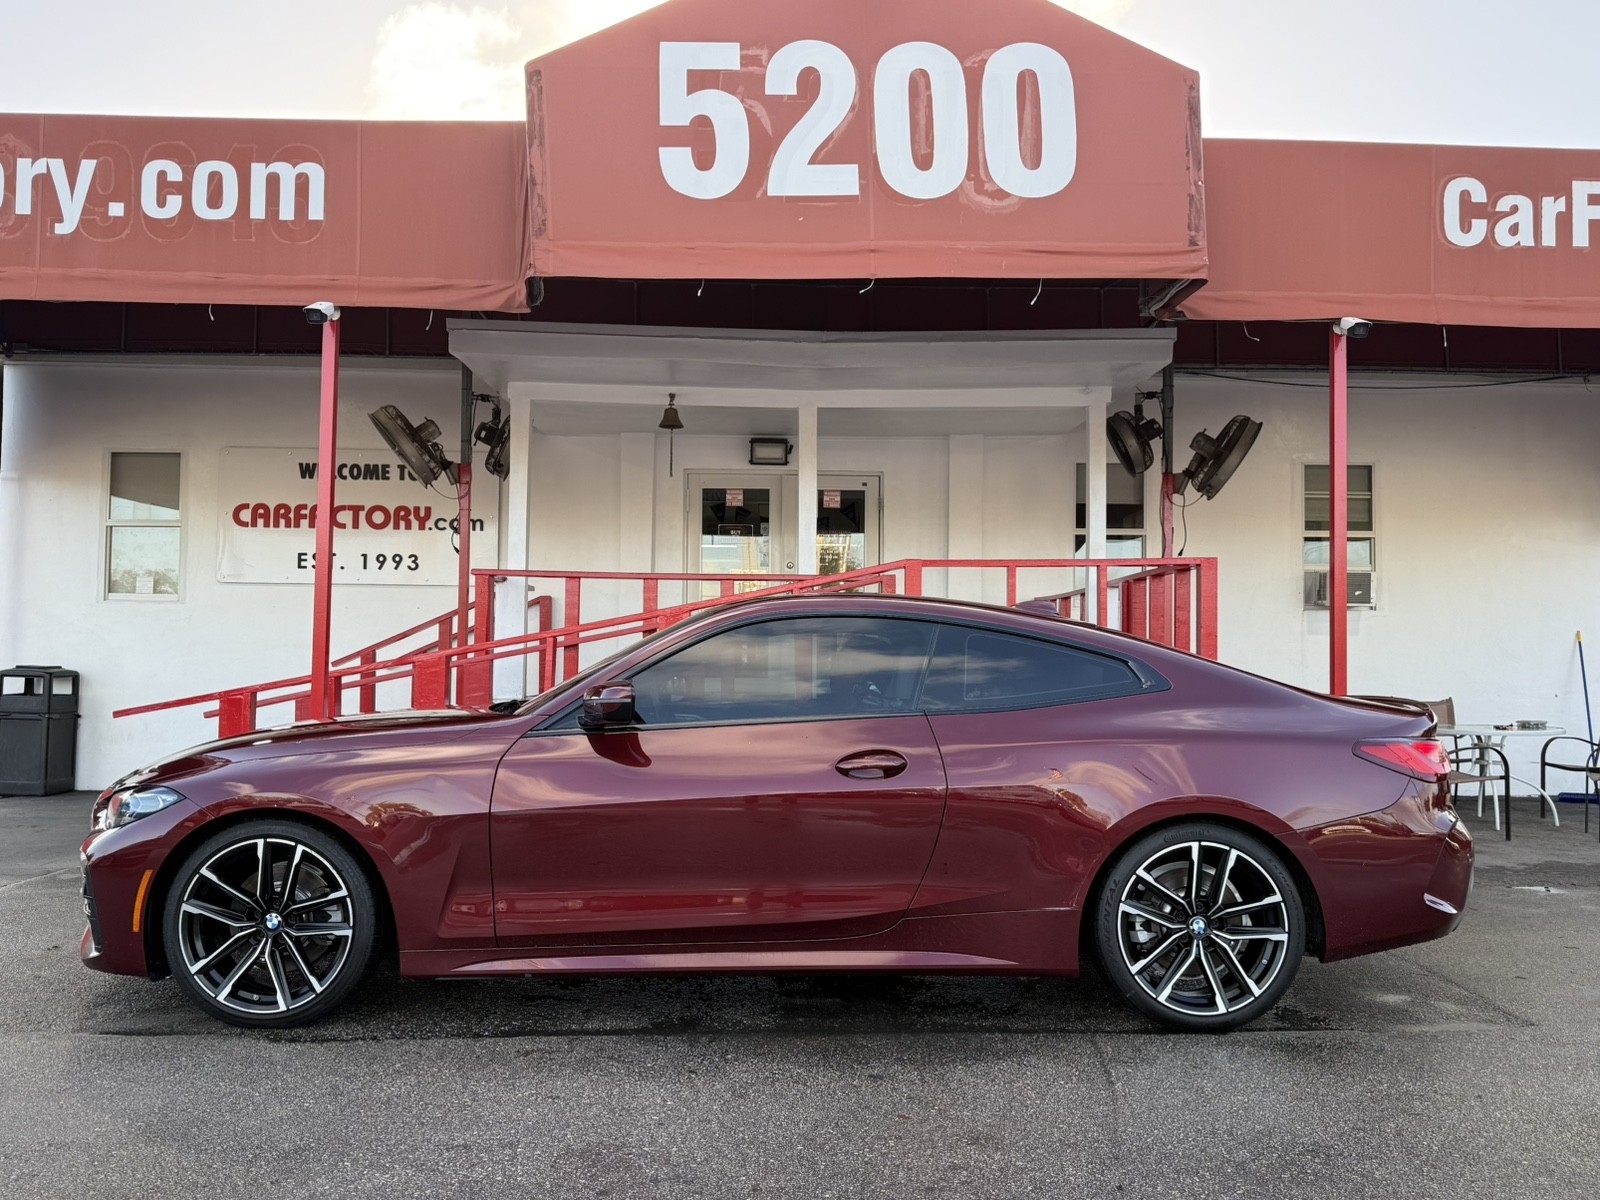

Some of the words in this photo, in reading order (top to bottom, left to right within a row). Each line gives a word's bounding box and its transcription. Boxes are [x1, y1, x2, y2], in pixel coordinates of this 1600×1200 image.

[659, 40, 1077, 199] 5200
[0, 157, 325, 235] ry.com
[1443, 176, 1600, 248] CarF
[299, 462, 391, 480] WCOME
[360, 553, 419, 570] 1993
